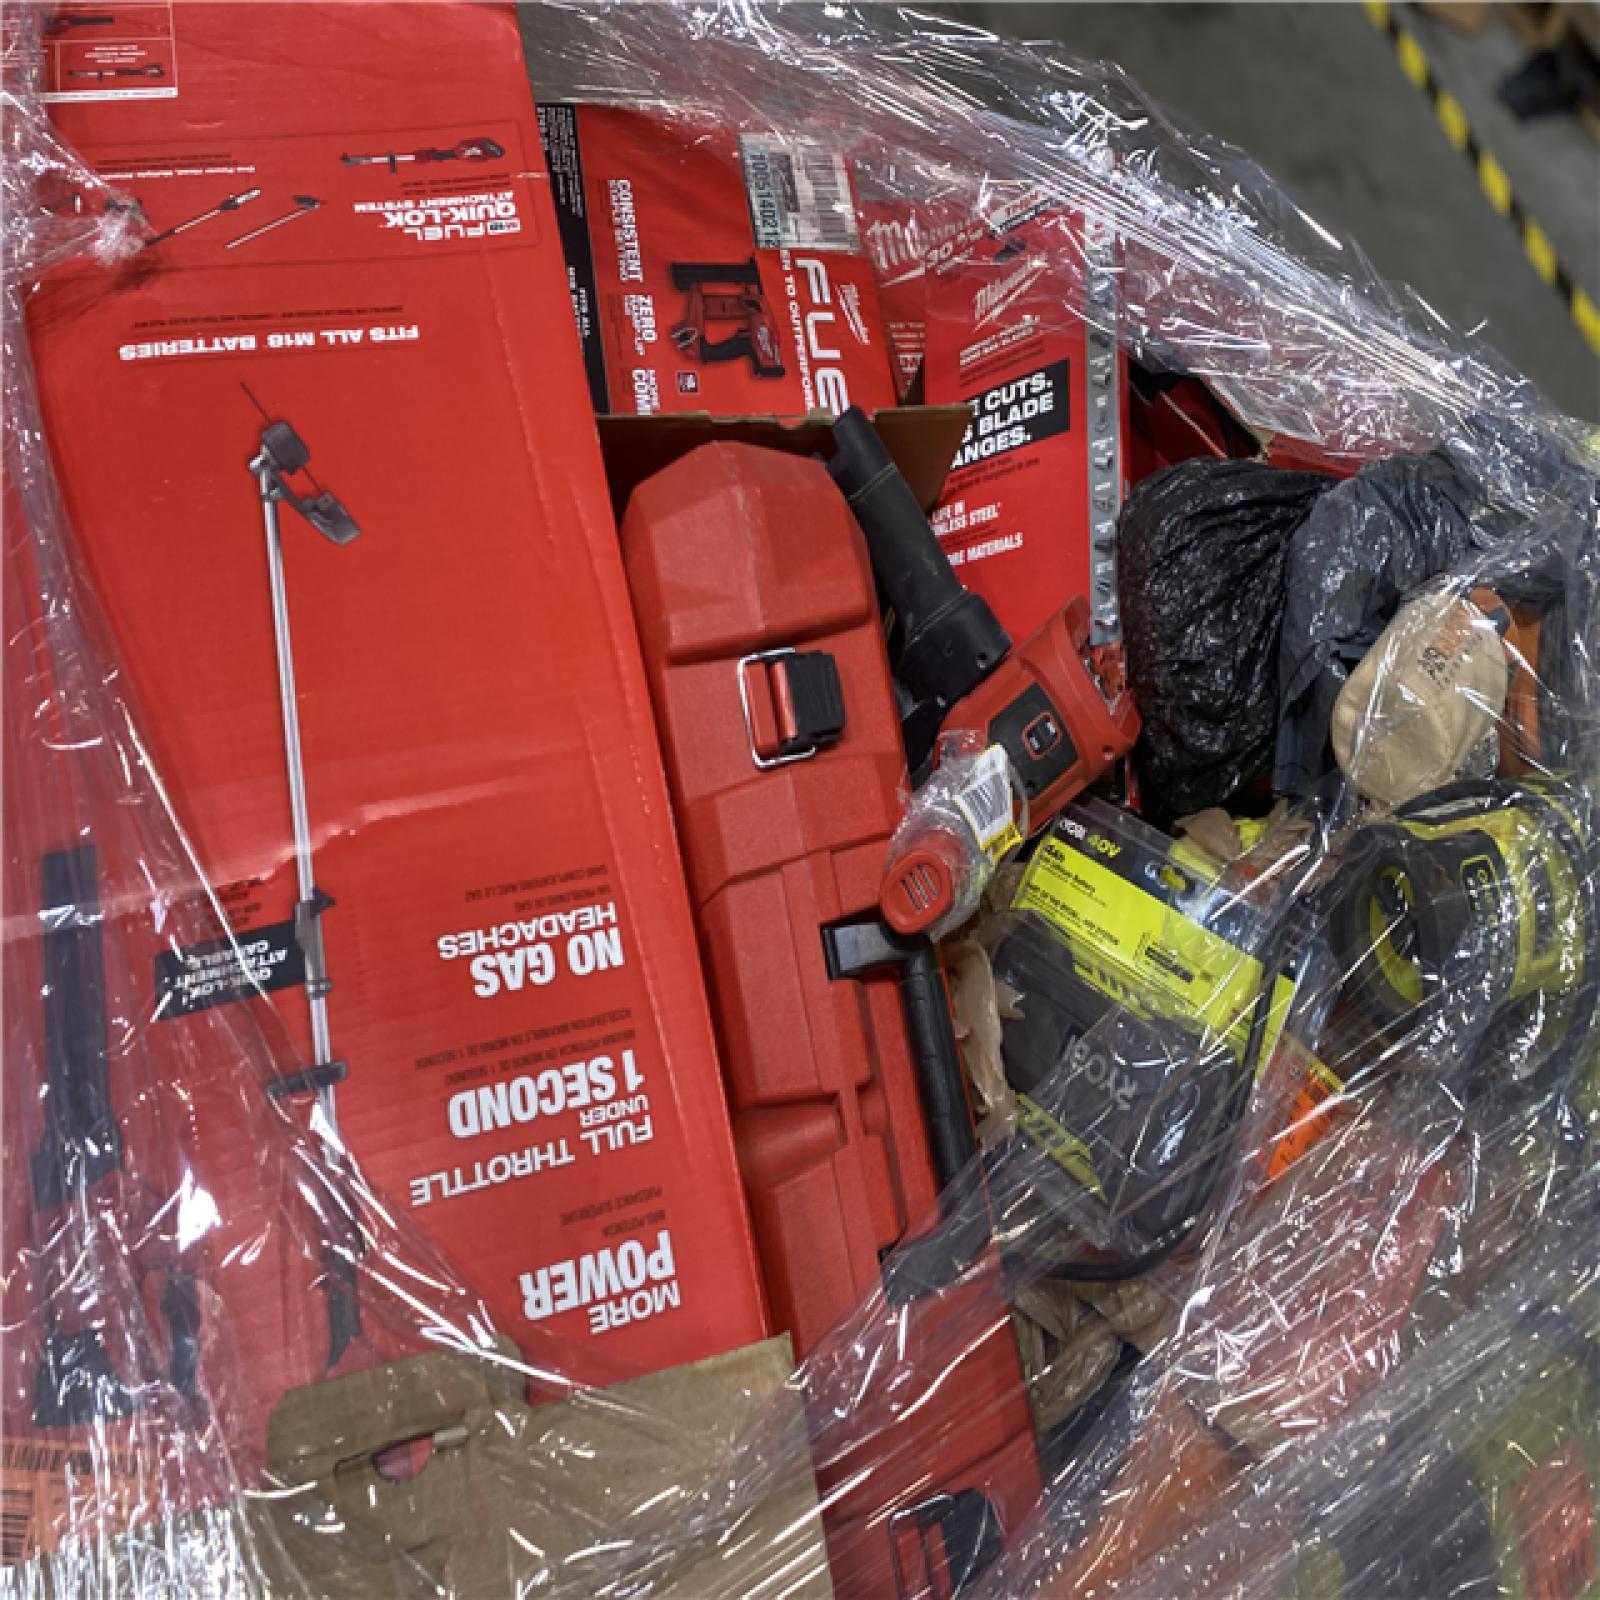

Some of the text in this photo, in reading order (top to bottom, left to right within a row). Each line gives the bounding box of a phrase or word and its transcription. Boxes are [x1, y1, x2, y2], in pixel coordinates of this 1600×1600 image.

[383, 202, 516, 228] QUIK-LOK
[617, 179, 643, 283] CONSISTENT
[784, 274, 796, 297] TO
[119, 325, 419, 361] FITS ALL M18 BATTERIES
[638, 295, 658, 343] ZERO
[979, 392, 1055, 436] BLADE
[984, 372, 1053, 411] CUTS.
[1087, 833, 1122, 858] 40V
[437, 901, 619, 960] HEADACHES
[469, 927, 625, 998] NO GAS
[448, 1049, 644, 1139] 1 SECOND
[579, 1094, 649, 1127] UNDER
[409, 1115, 653, 1207] FULL THROTTLE
[519, 1230, 675, 1320] POWER
[587, 1280, 681, 1334] MORE
